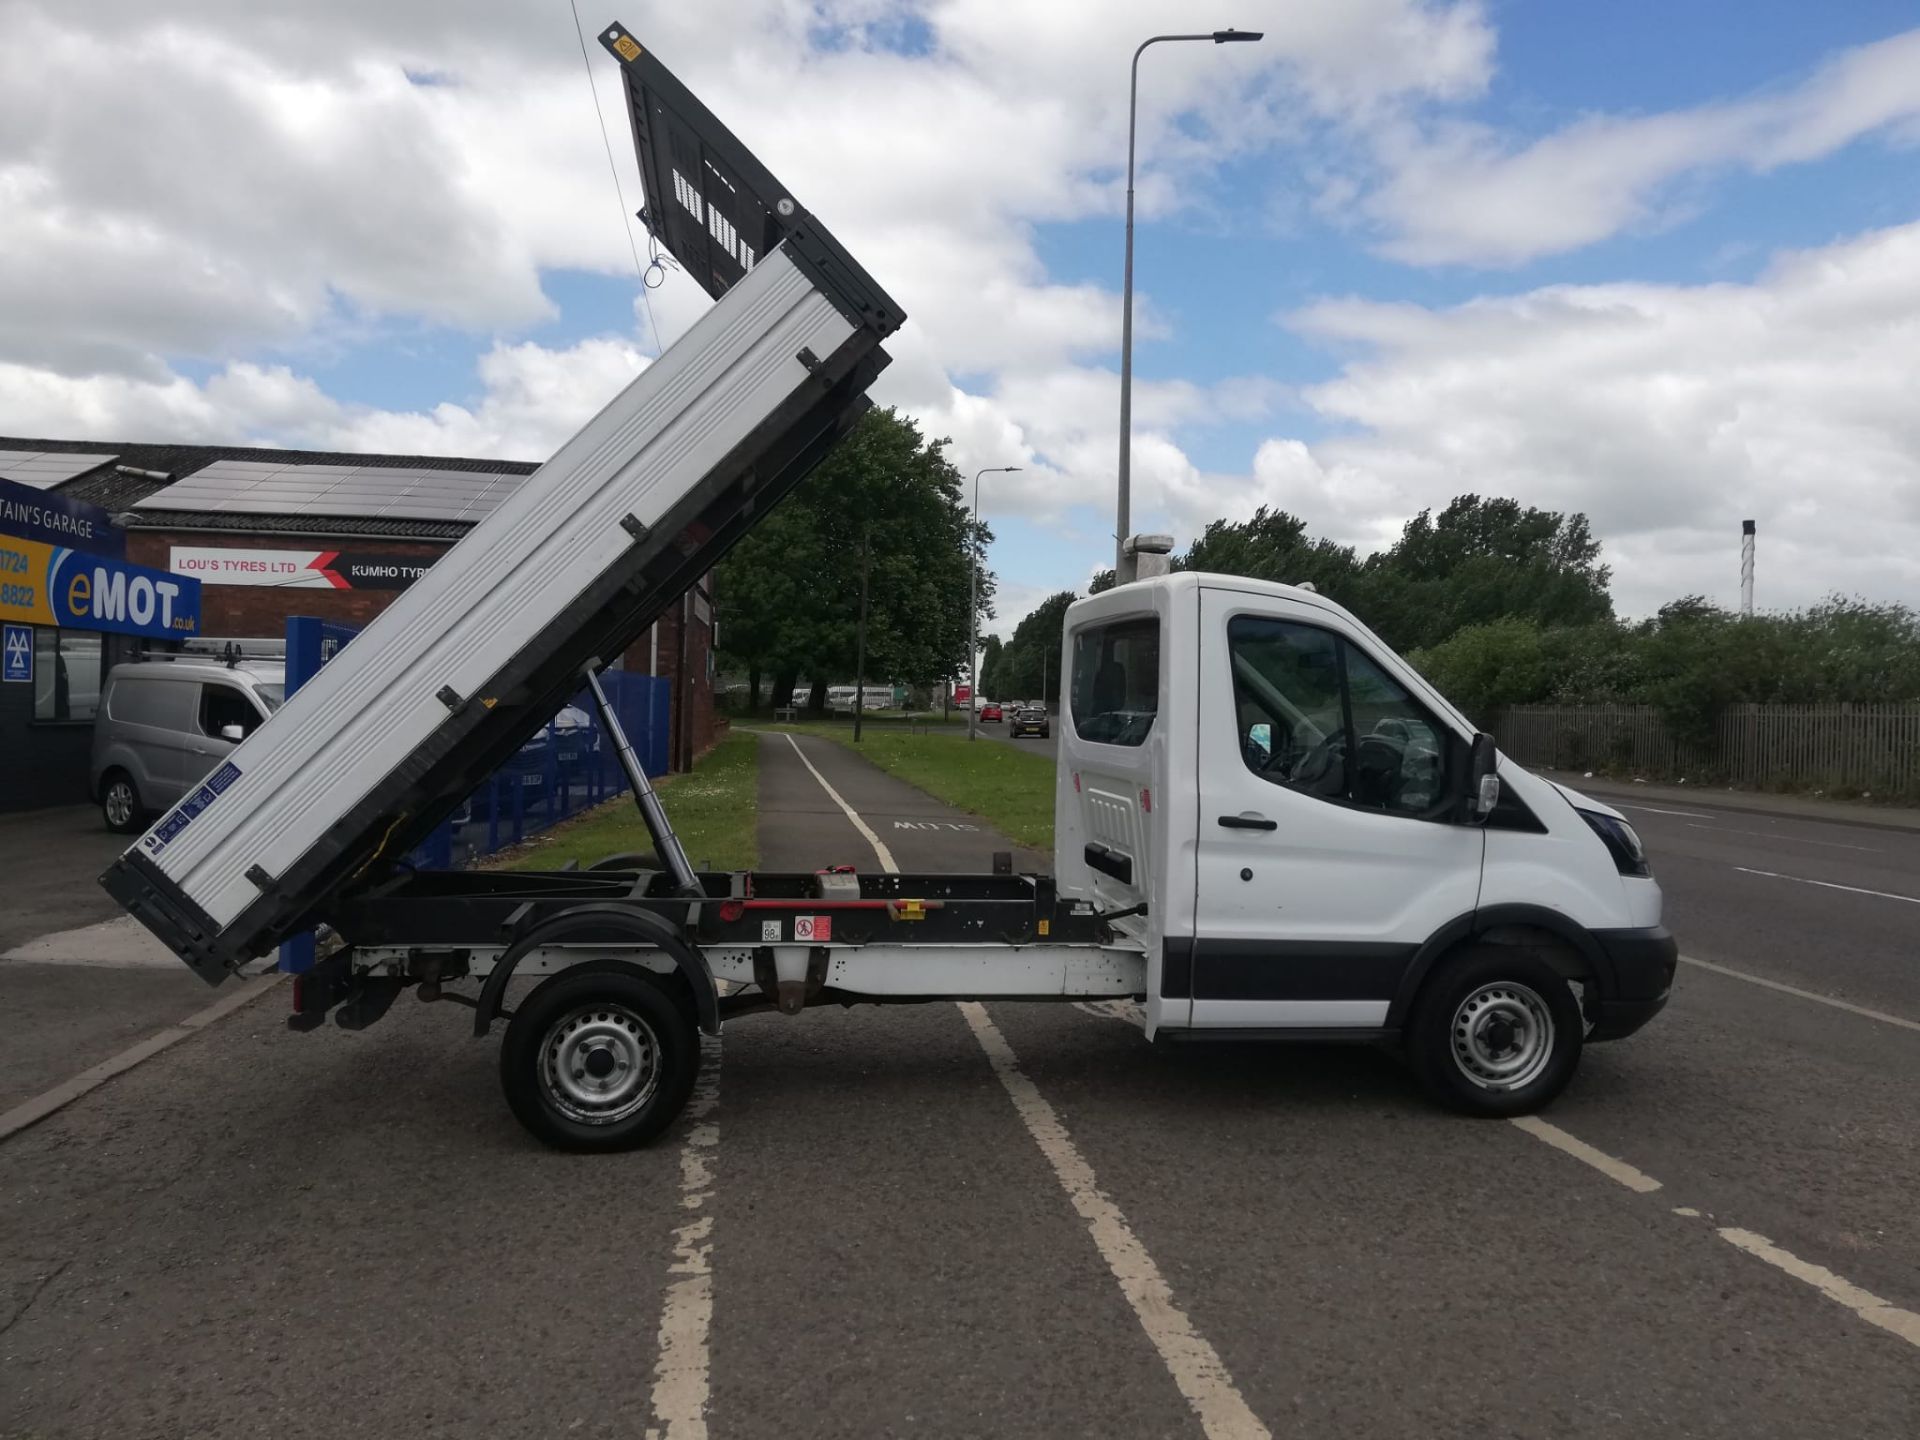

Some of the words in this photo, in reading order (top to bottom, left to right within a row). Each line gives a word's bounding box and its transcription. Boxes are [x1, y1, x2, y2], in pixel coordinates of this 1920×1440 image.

[44, 510, 93, 538] GARAGE
[178, 559, 219, 571] LOU'S
[223, 560, 267, 572] TYRES
[271, 562, 297, 573] LTD
[352, 565, 398, 577] KUMHO
[400, 567, 431, 578] TYR
